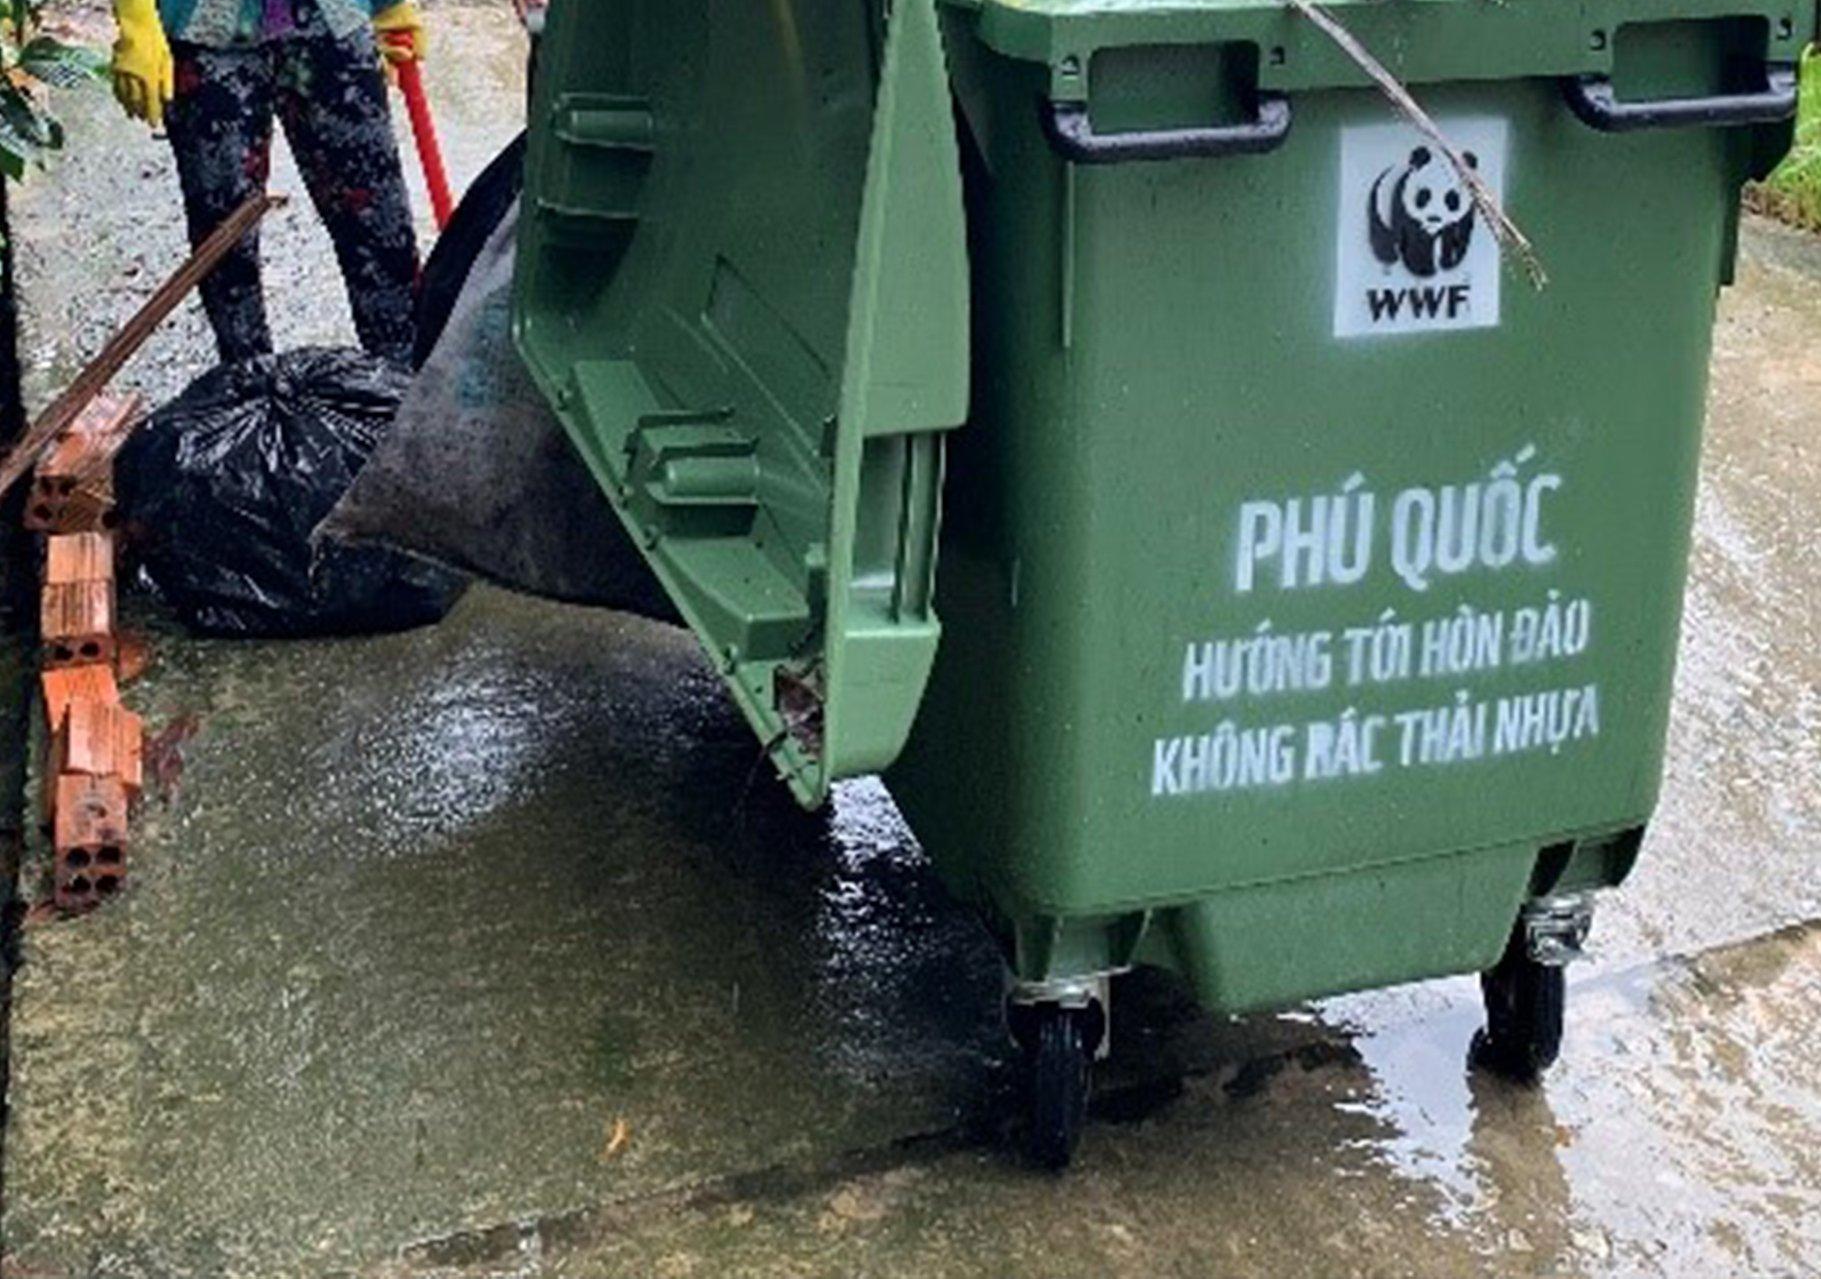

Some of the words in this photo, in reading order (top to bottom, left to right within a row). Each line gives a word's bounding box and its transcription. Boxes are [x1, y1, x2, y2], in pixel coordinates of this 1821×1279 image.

[1366, 284, 1471, 322] WWF
[1234, 471, 1375, 593] PHÚ
[1390, 444, 1563, 592] QUỐC
[1418, 602, 1504, 676] HÒN
[1509, 588, 1591, 665] ĐẢO
[1151, 718, 1297, 796] KHÔNG
[1303, 705, 1387, 780] RÁC
[1493, 684, 1601, 756] NHỰA
